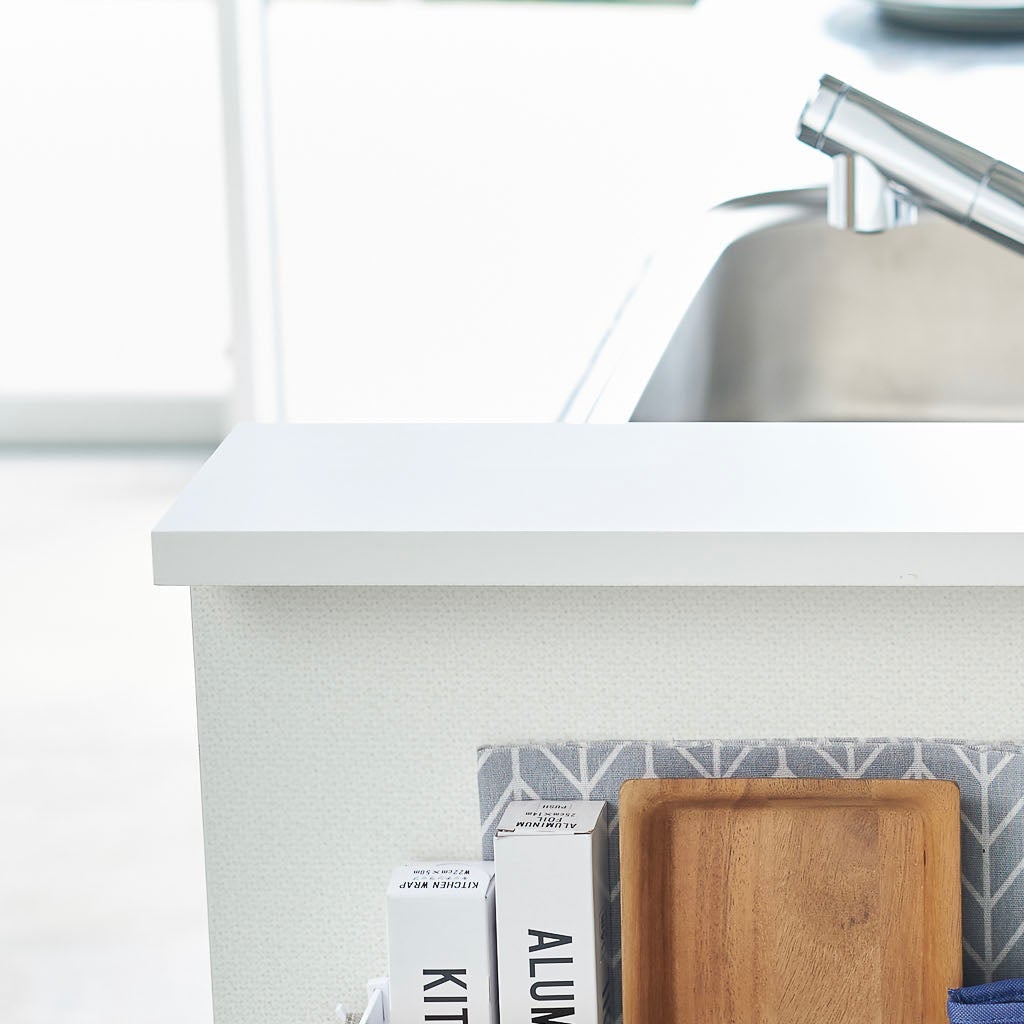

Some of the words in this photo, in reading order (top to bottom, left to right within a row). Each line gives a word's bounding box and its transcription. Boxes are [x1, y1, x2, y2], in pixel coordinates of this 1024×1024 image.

[515, 821, 577, 829] ALUMINUM
[399, 881, 428, 889] WRAP
[432, 881, 479, 889] KITCHEN
